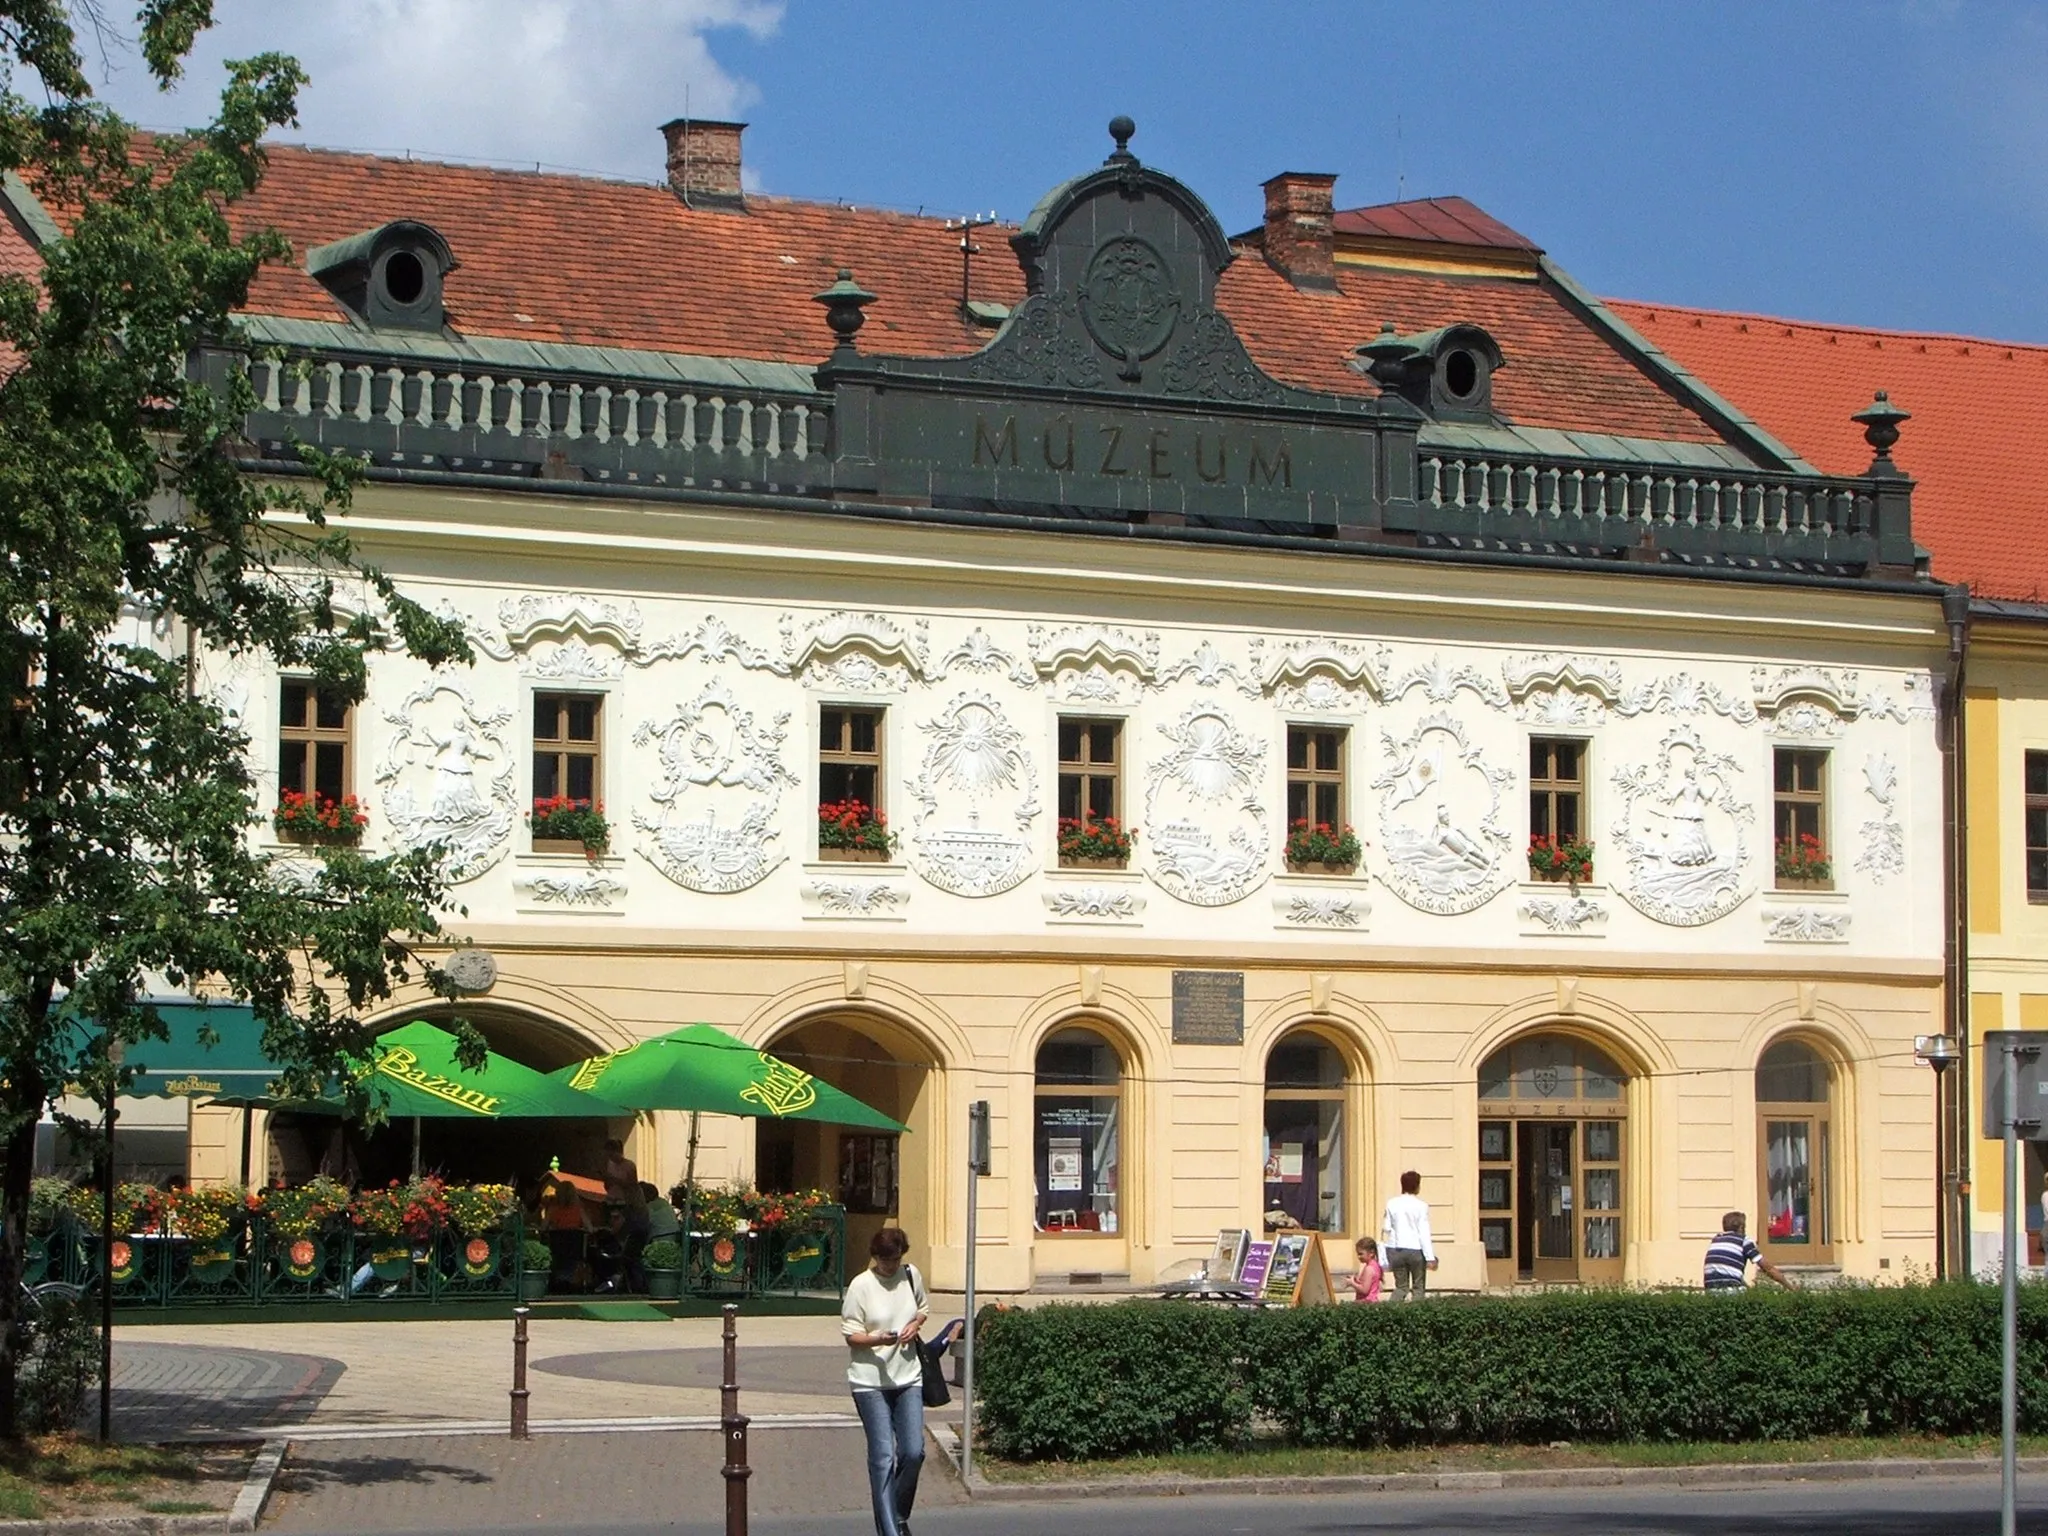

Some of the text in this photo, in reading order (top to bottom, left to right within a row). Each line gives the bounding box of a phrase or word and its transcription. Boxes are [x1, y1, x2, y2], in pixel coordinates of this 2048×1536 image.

[972, 411, 1293, 489] MÚZEUM
[1460, 886, 1496, 911] CUSTOS
[1655, 910, 1693, 926] OCULOS
[376, 1046, 502, 1115] Bažant
